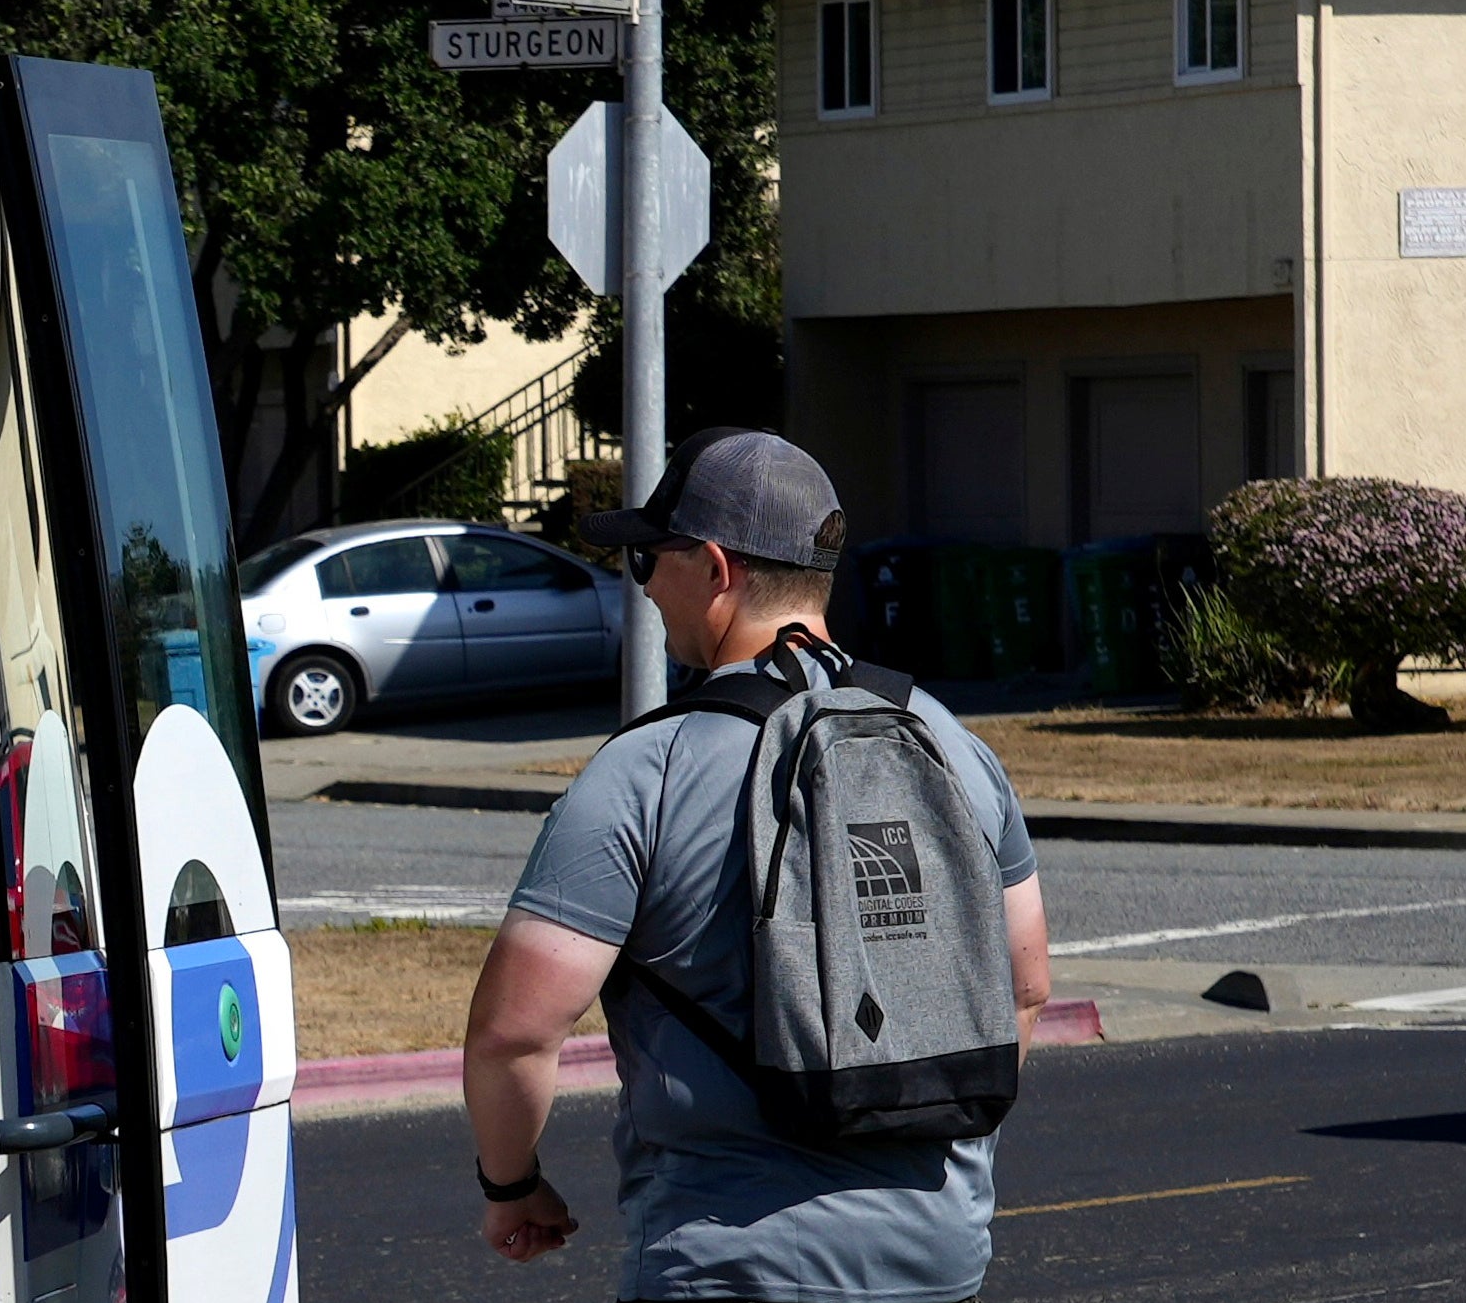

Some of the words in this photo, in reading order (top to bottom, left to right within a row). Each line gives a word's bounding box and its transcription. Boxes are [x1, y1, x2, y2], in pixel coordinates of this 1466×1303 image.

[447, 28, 606, 59] STURGEON
[881, 826, 908, 846] ICC
[858, 898, 893, 912] DIGITAL
[895, 896, 924, 910] CODES
[861, 911, 924, 927] PREMIUM
